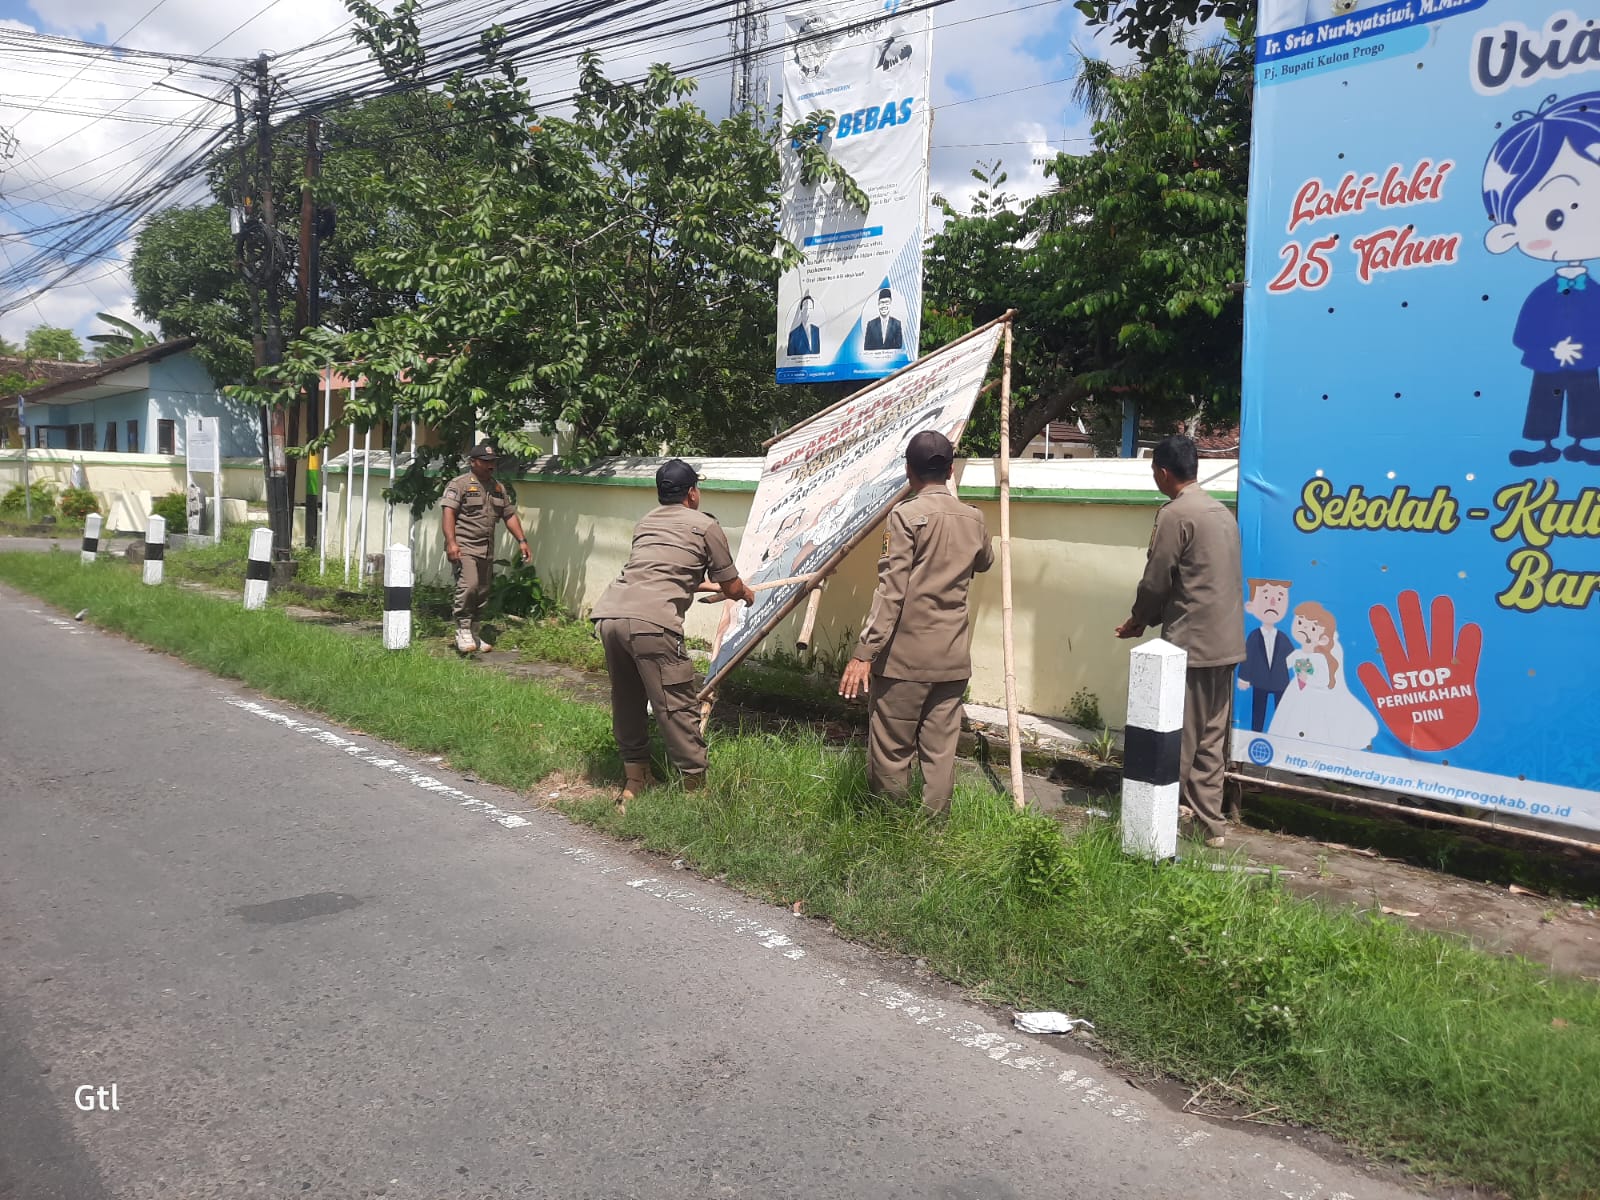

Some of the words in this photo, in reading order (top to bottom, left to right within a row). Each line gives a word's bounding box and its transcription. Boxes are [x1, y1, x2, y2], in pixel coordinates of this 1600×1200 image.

[1264, 67, 1278, 80] Pj.
[1281, 57, 1314, 76] Bupati
[1317, 51, 1350, 67] Kulon
[1353, 43, 1385, 59] Progo
[1265, 39, 1281, 56] Ir.
[1285, 30, 1314, 51] Srie
[835, 97, 914, 139] BEBAS
[1289, 161, 1451, 232] Laki-laki
[1268, 236, 1338, 292] 25
[1353, 229, 1459, 282] Tahun
[1295, 479, 1458, 533] Sekolah
[1377, 683, 1473, 709] PERNIKAHAN
[1392, 667, 1452, 691] STOP
[1411, 707, 1445, 725] DINI
[1284, 753, 1572, 819] http://pemberdayaan.kulonprogokab.go.id
